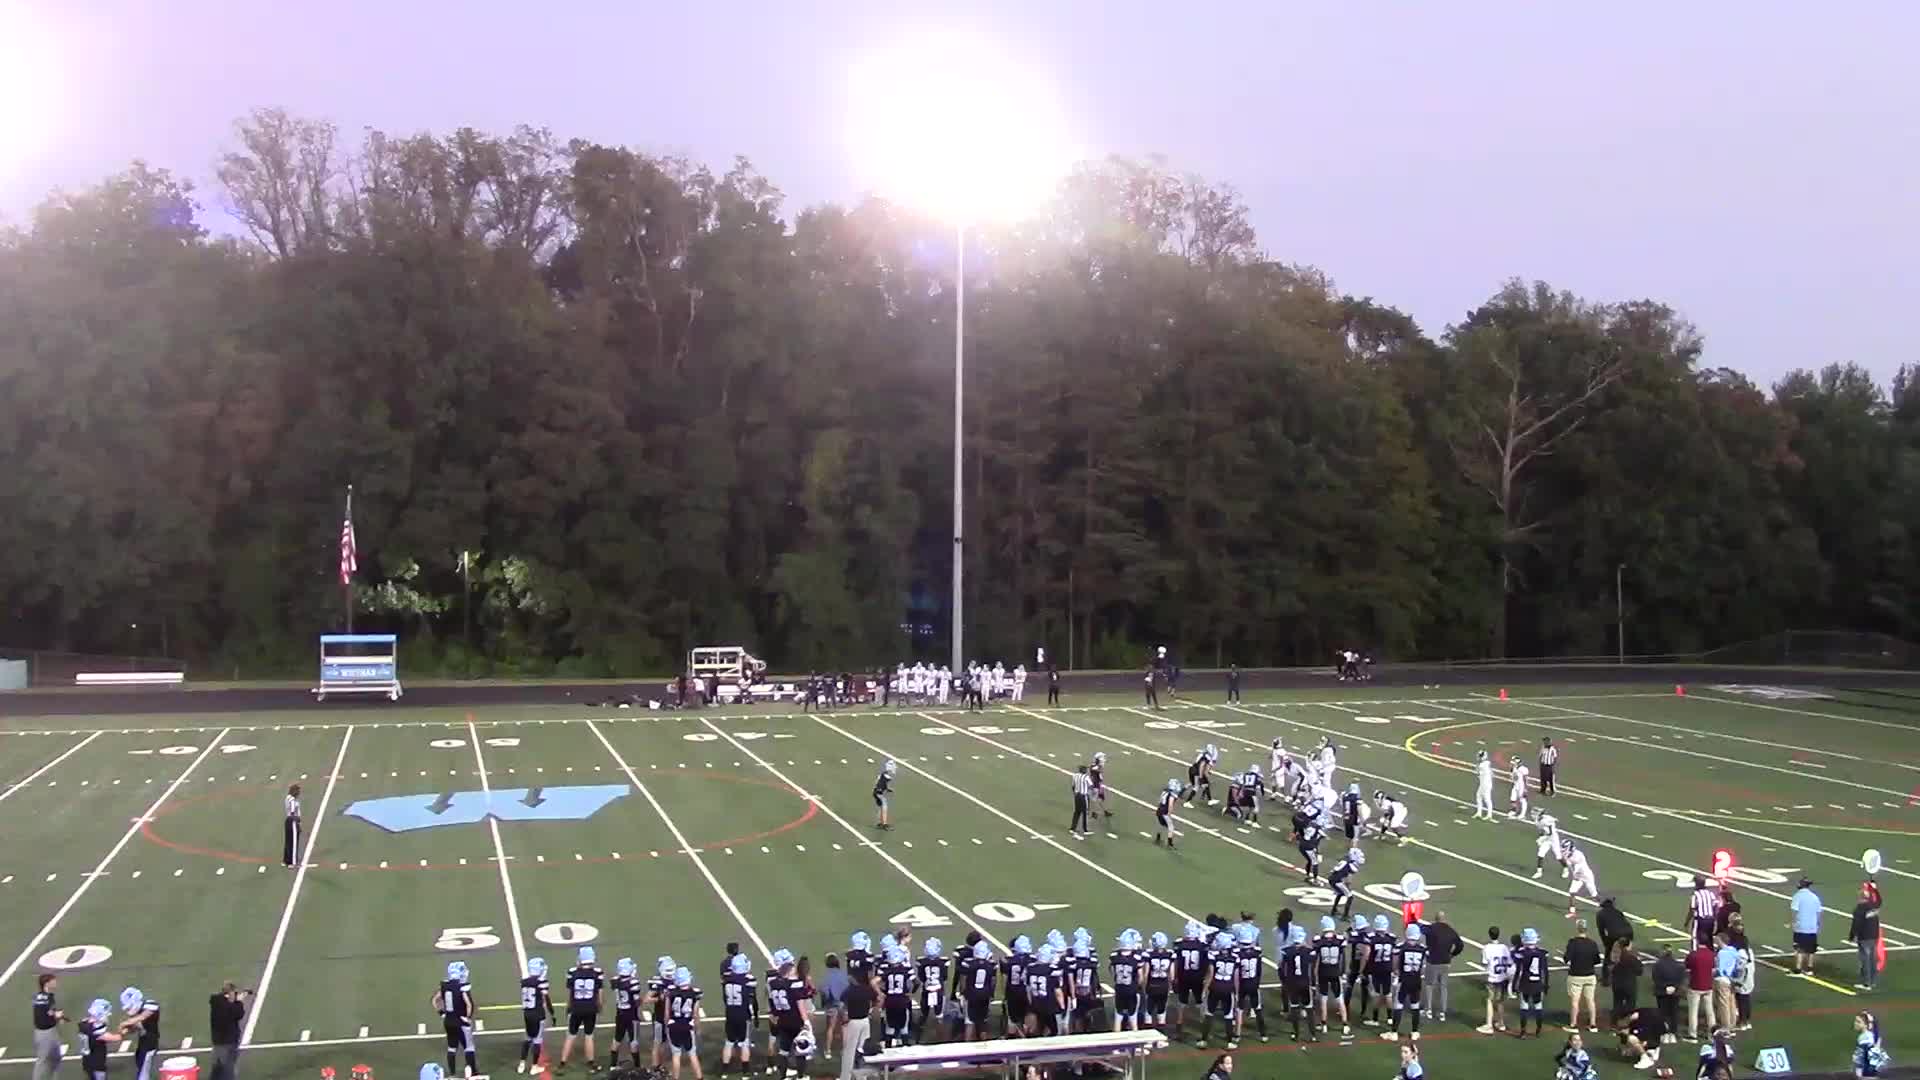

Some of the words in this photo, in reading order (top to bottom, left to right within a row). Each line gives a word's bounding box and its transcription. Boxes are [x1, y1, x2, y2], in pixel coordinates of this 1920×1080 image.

[1713, 851, 1731, 878] 2
[1294, 955, 1302, 976] 1
[1529, 957, 1540, 981] 4
[887, 974, 904, 994] 13
[671, 996, 694, 1018] 44
[1767, 1052, 1785, 1070] 30
